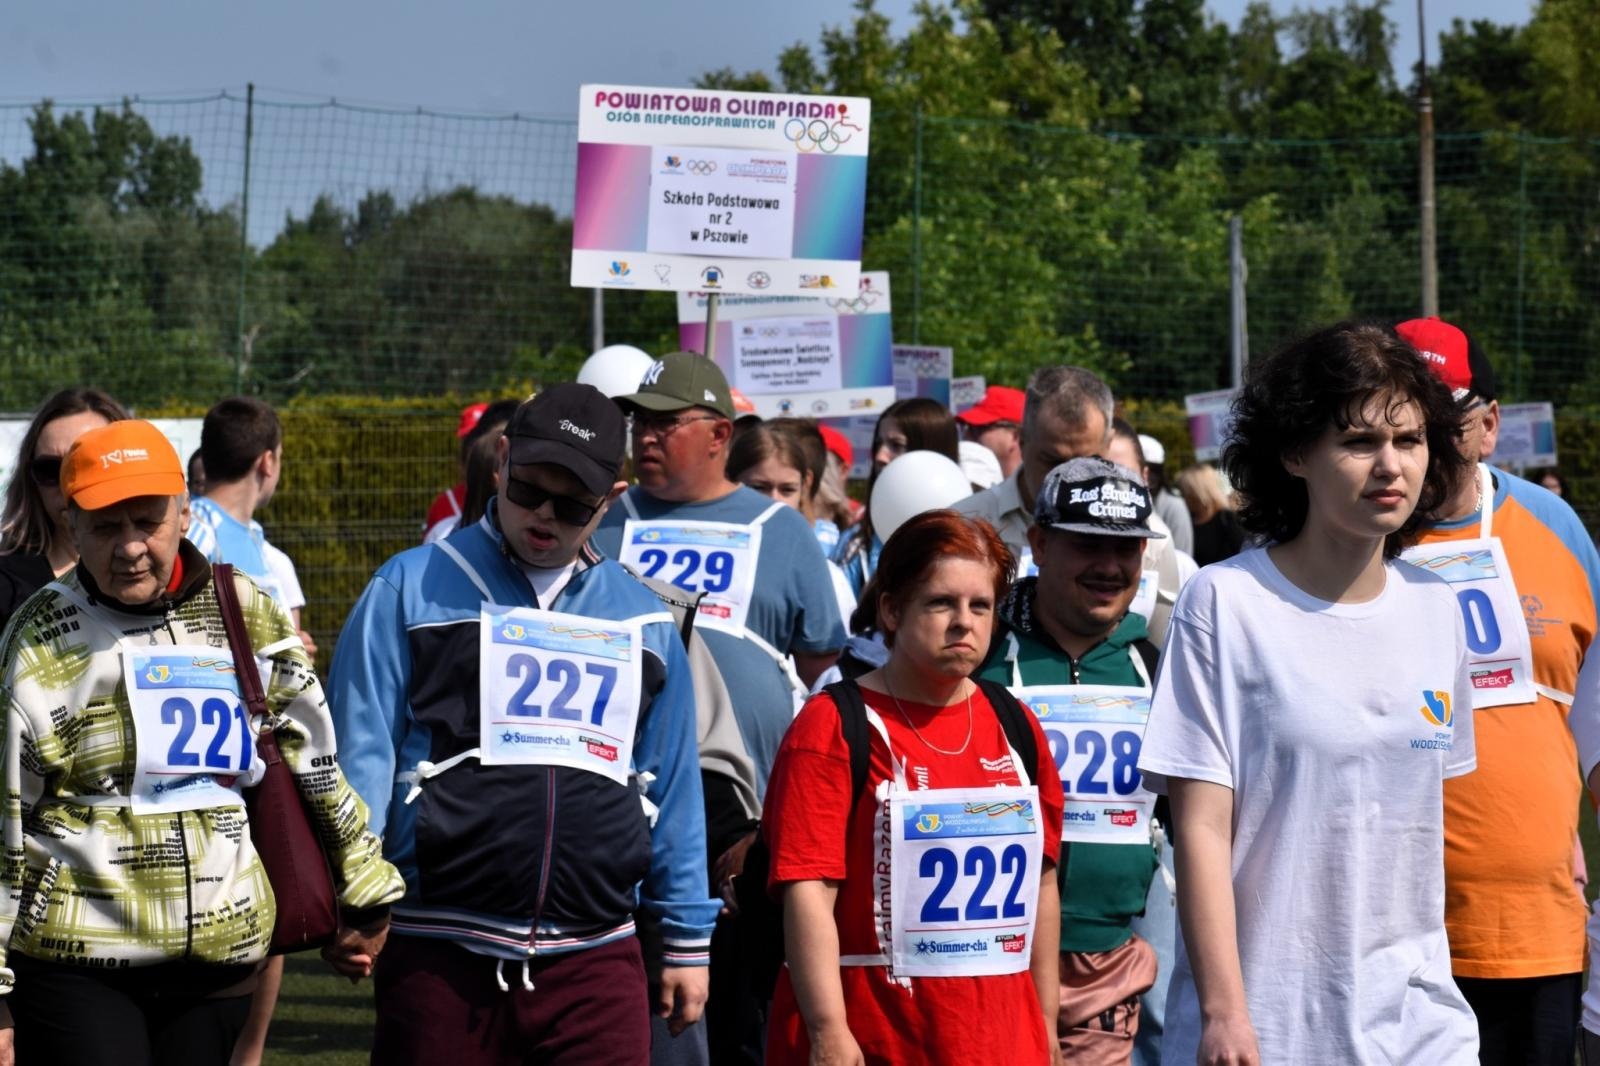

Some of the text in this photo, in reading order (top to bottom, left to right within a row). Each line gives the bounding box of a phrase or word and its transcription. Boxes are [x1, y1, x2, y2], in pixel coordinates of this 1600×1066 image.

[595, 91, 836, 119] POWIATOWA OLIMPIADA
[606, 110, 641, 123] OSÓB
[663, 190, 780, 210] Szkoła Podstawowa
[709, 211, 733, 225] nr 2
[690, 228, 748, 244] w Pszowie
[1069, 486, 1100, 504] Los
[1088, 502, 1137, 519] Crimes
[639, 549, 735, 593] 229
[506, 652, 618, 727] 227
[1475, 675, 1509, 687] EFEKT
[160, 697, 253, 771] 221
[514, 732, 570, 747] Summer-cha
[1044, 729, 1142, 795] 228
[919, 843, 1027, 923] 222
[929, 939, 988, 954] Summer-cha
[1004, 940, 1024, 951] EFEKT
